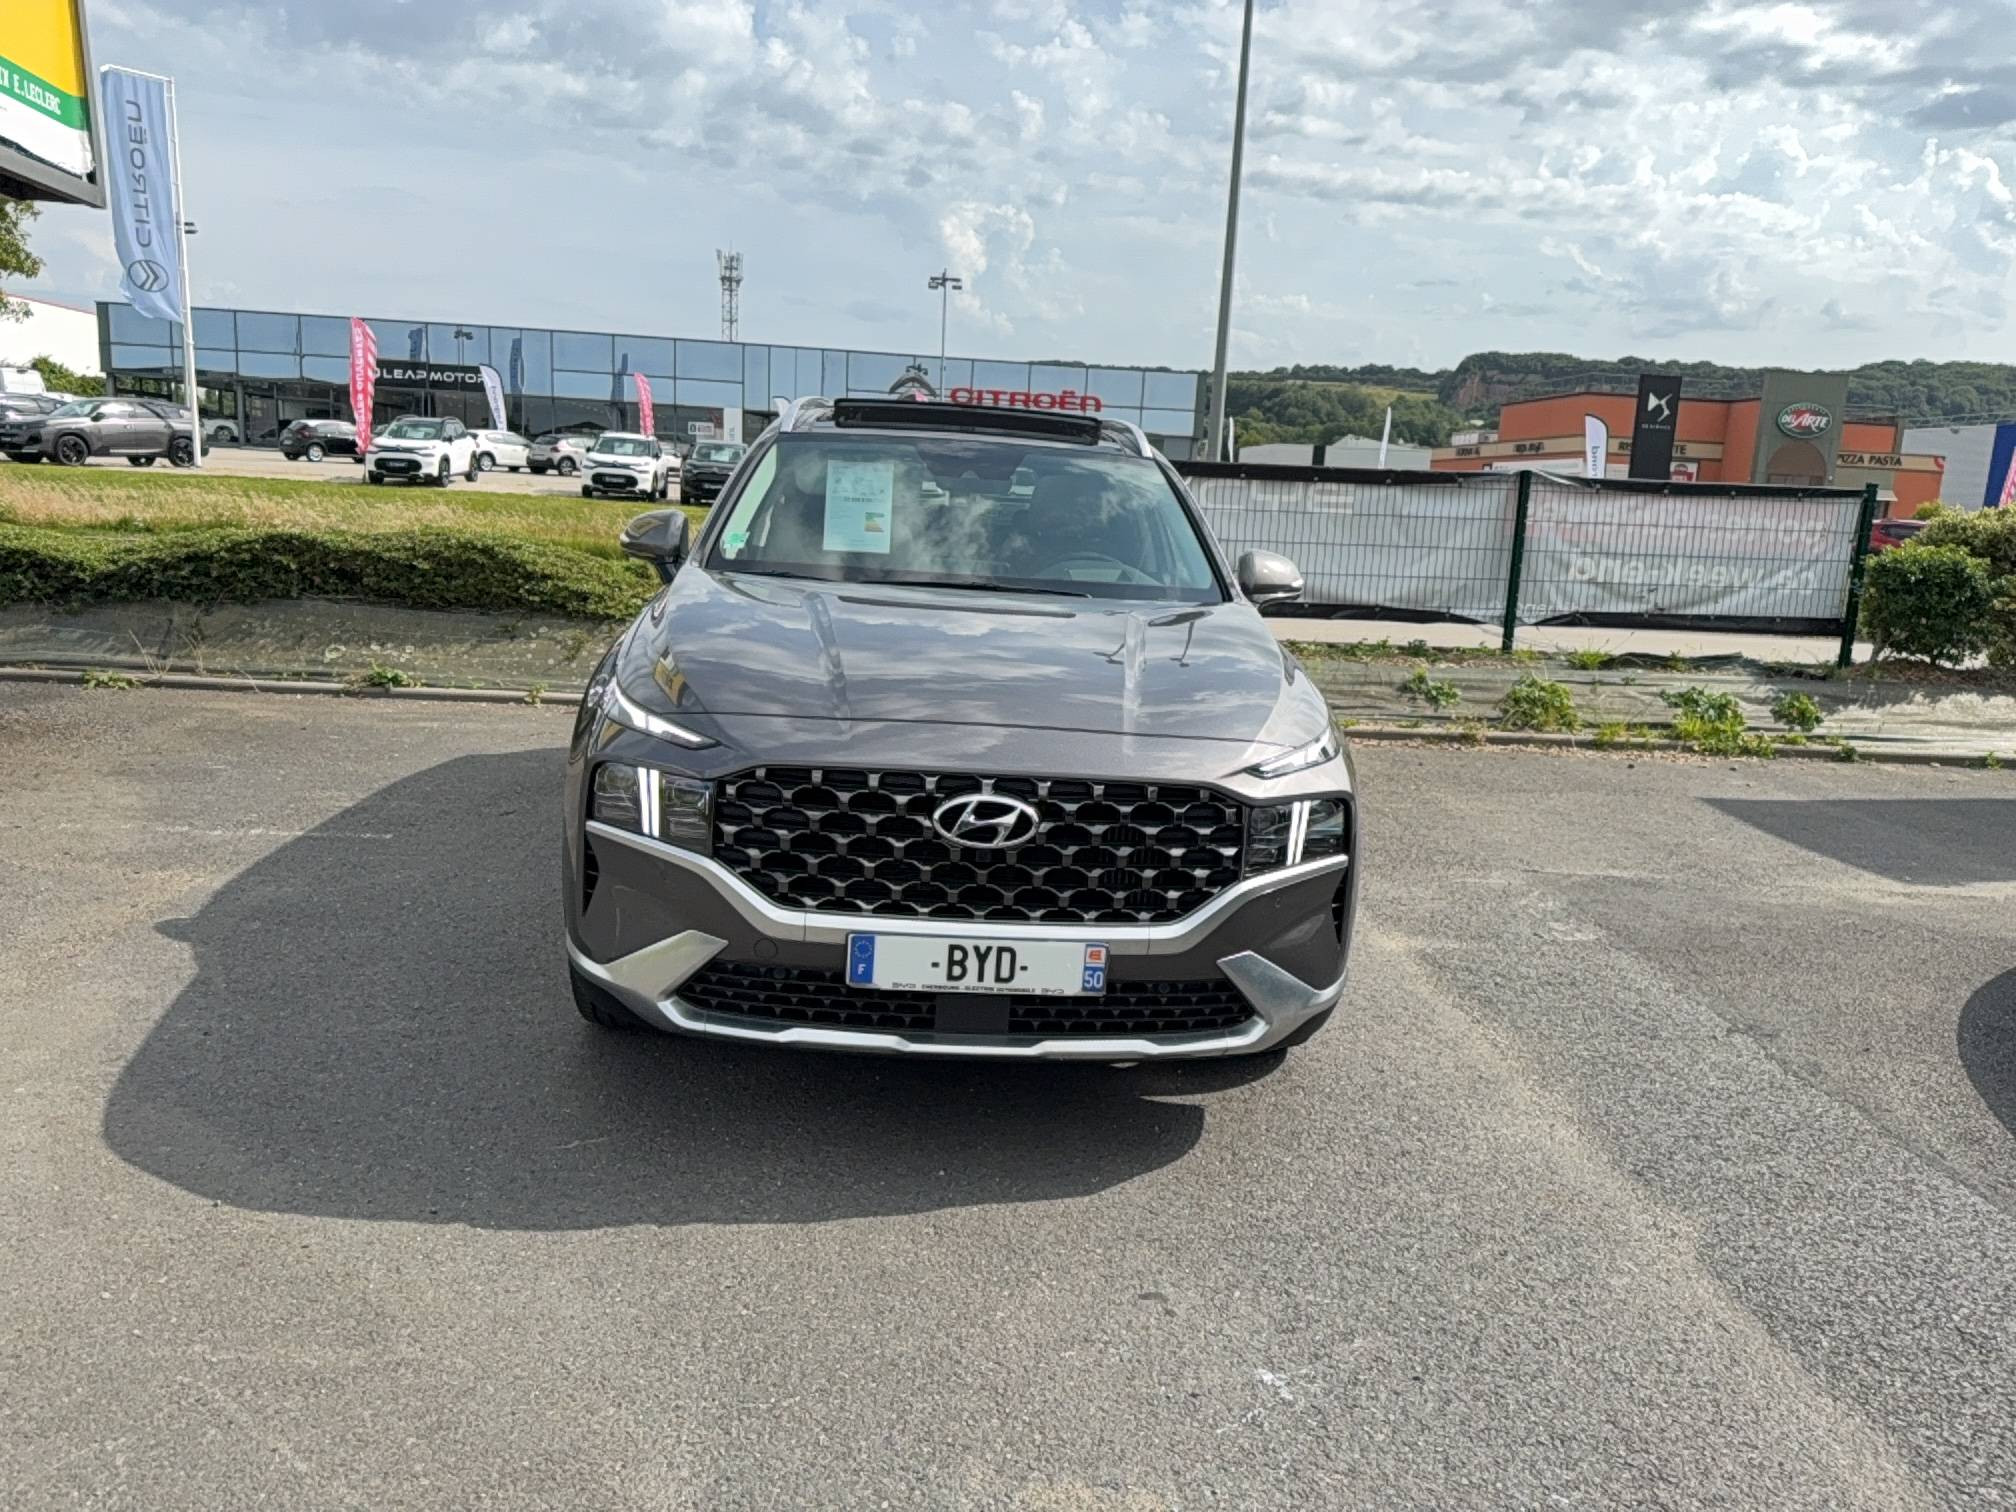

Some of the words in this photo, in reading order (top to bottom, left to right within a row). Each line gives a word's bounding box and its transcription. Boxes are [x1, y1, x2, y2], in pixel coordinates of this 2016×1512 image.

[1868, 455, 1902, 466] PASTA
[857, 963, 866, 975] F
[1083, 970, 1104, 988] 50
